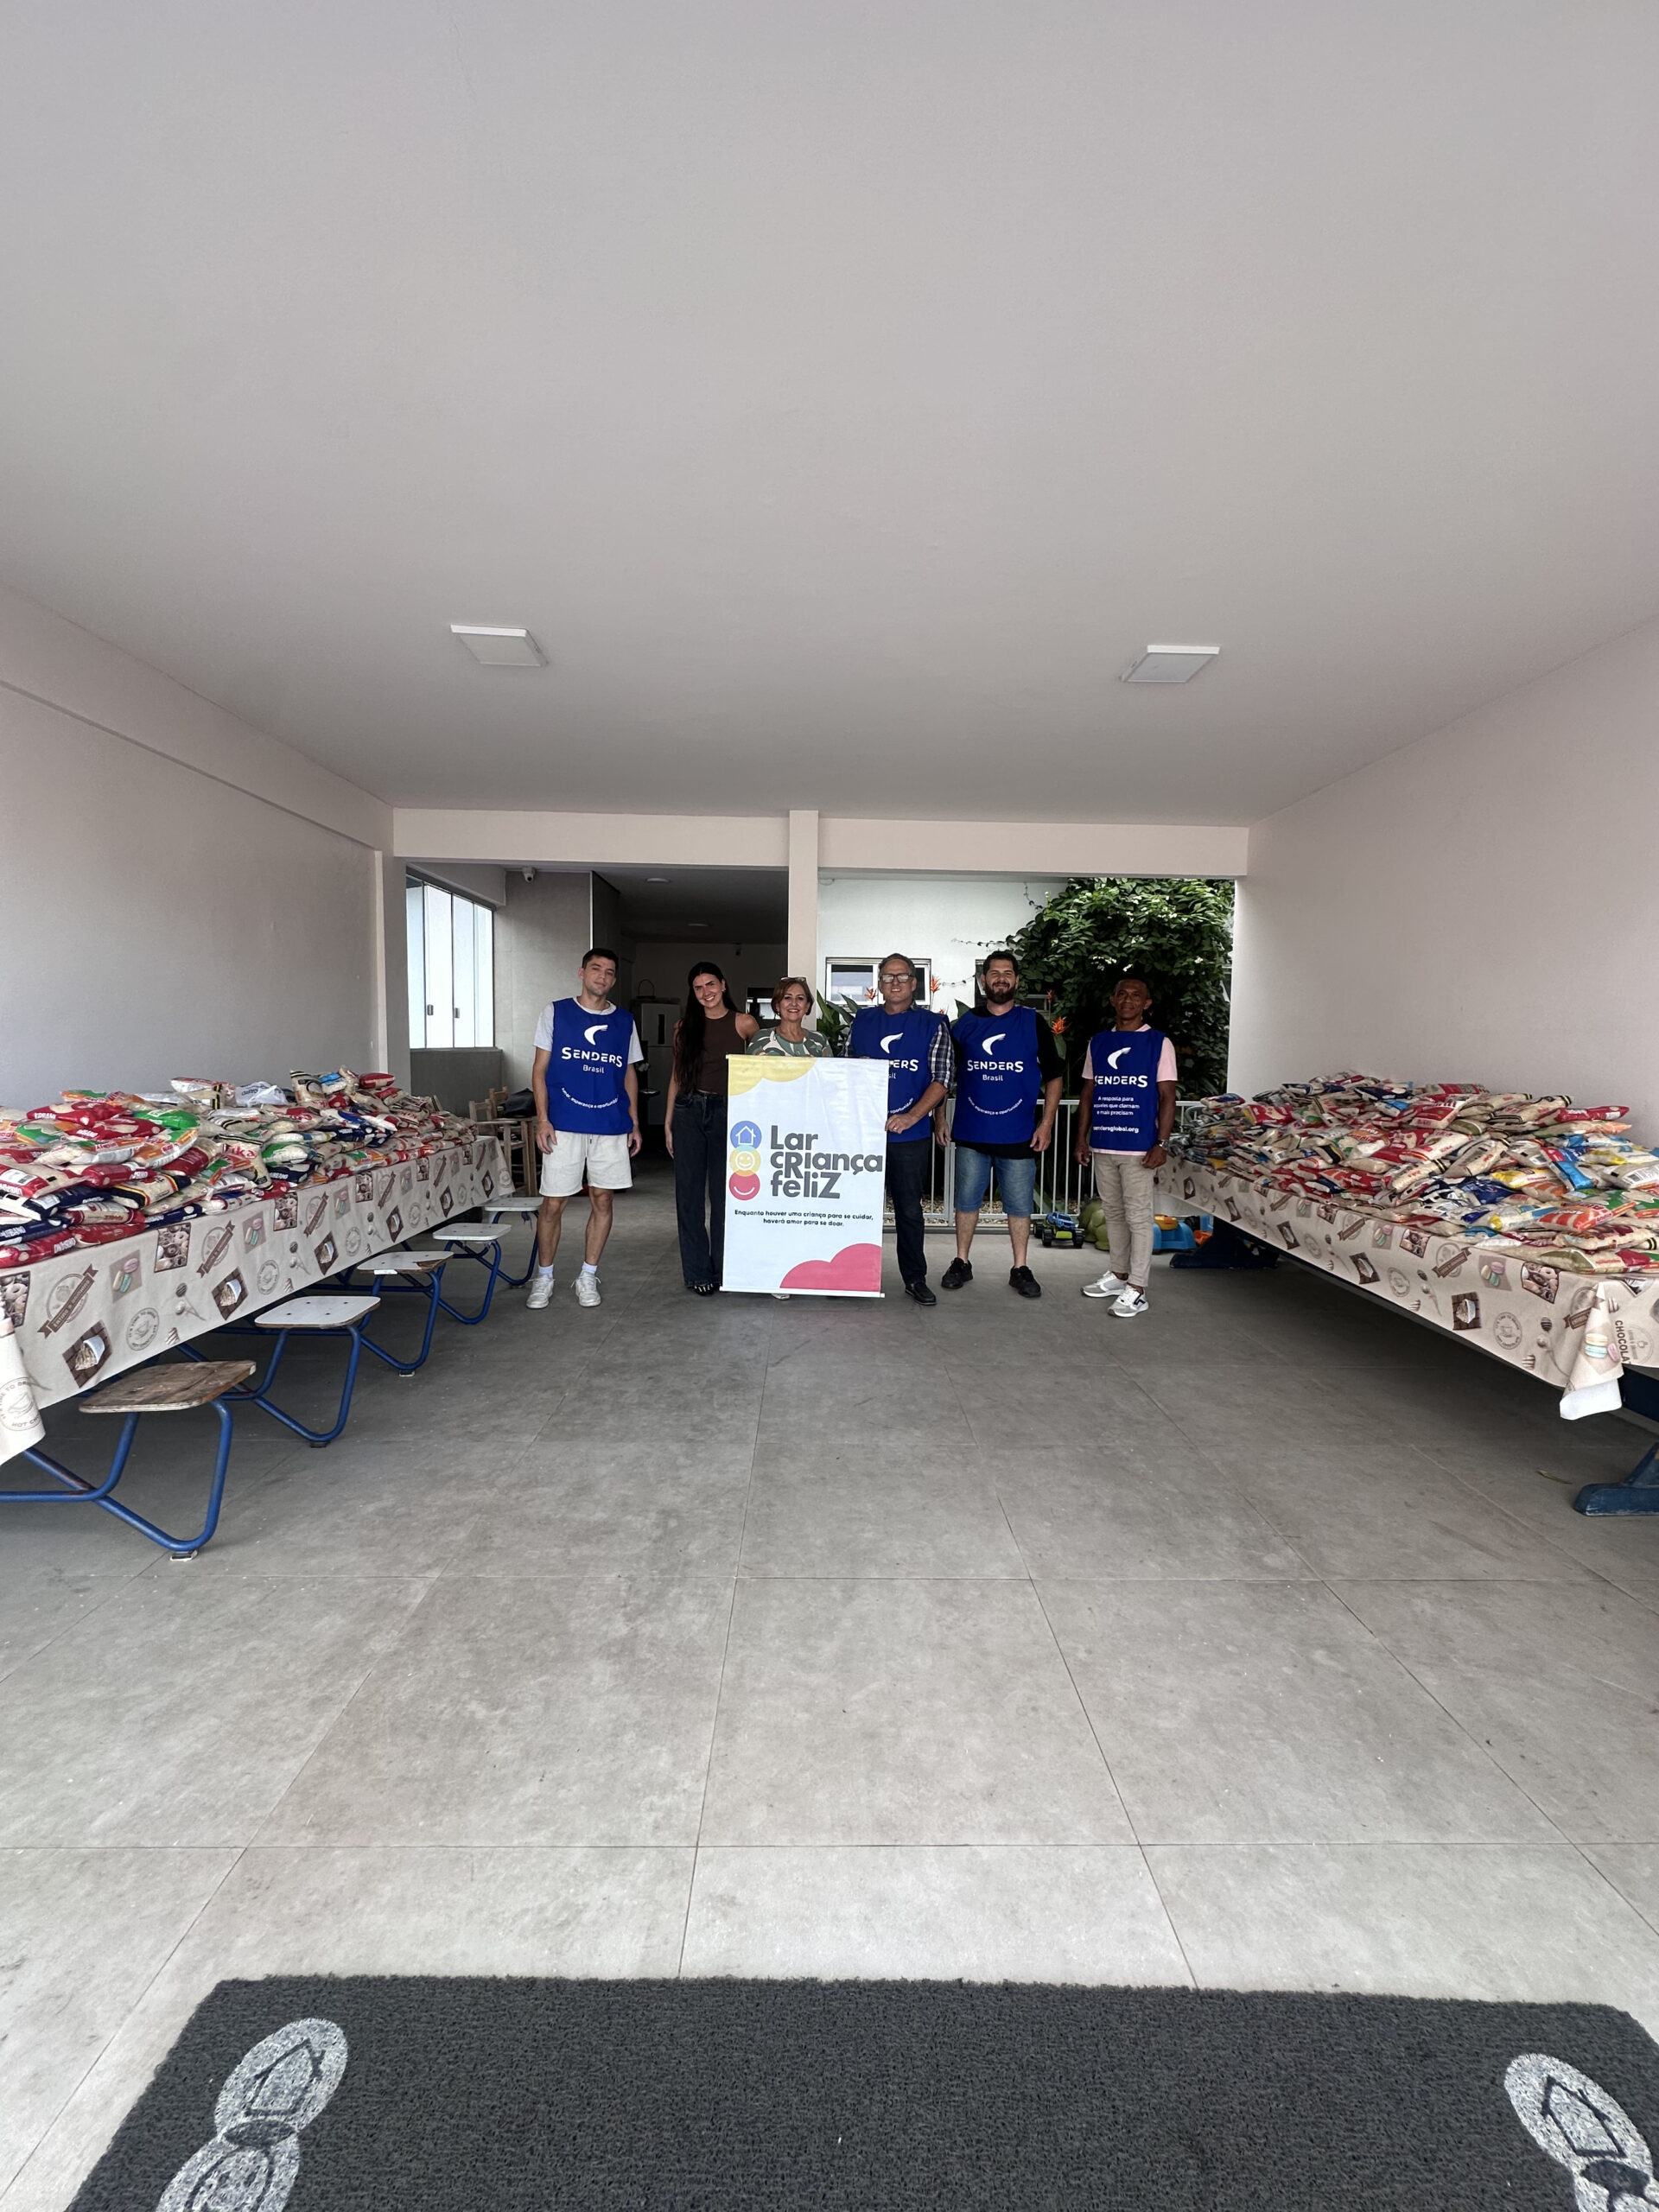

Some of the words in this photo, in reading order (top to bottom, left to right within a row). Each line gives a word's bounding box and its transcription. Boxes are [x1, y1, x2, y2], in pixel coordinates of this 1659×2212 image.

[562, 1046, 623, 1068] SENDERS
[582, 1064, 605, 1074] Brasil
[967, 1059, 1024, 1073] SENDERS
[982, 1073, 1003, 1082] Brasil
[770, 1125, 818, 1151] Lar
